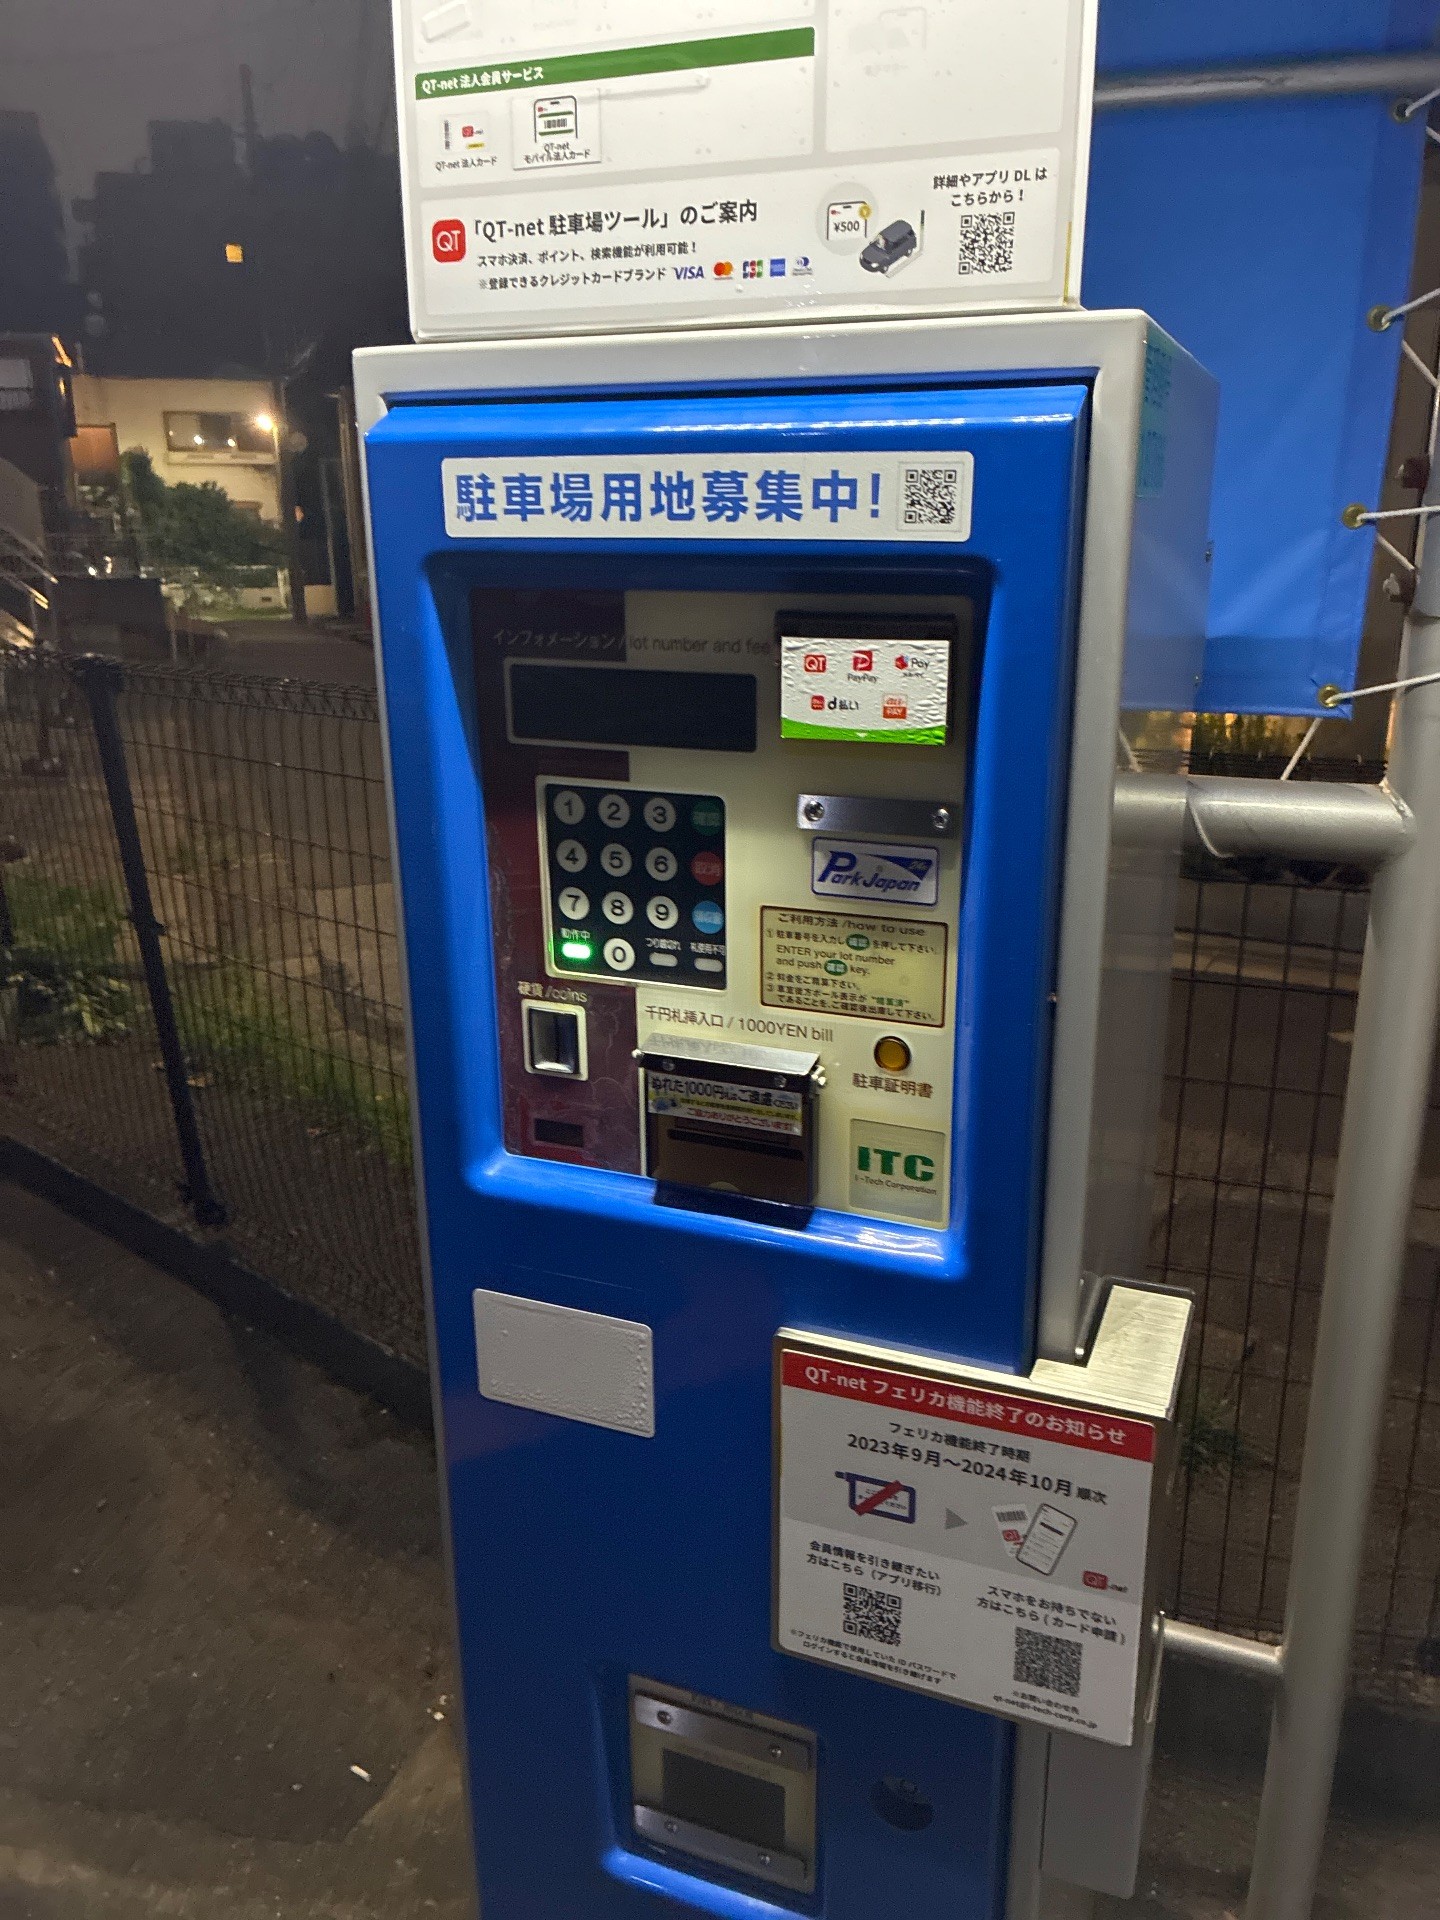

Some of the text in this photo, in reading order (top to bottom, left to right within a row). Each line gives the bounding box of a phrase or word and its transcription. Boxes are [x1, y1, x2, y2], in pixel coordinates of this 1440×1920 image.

[421, 66, 544, 94] QT-net 法人会員サービス
[1014, 169, 1030, 182] DL
[436, 230, 461, 252] QT
[673, 265, 704, 280] VISA
[652, 637, 707, 653] number
[713, 638, 742, 654] and
[805, 657, 826, 671] QT
[910, 658, 930, 669] Pay
[847, 673, 878, 685] PayPay
[564, 799, 573, 816] 1
[607, 802, 621, 820] 2
[653, 805, 667, 824] 3
[565, 848, 578, 864] 4
[609, 851, 623, 868] 5
[654, 855, 669, 873] 6
[567, 894, 580, 912] 7
[610, 899, 624, 916] 8
[655, 904, 669, 921] 9
[612, 946, 627, 963] 0
[776, 944, 811, 956] ENTER
[645, 1005, 724, 1028] 千円札挿入口
[738, 1018, 808, 1039] 1000YEN
[812, 1027, 834, 1043] bill
[852, 1073, 933, 1098] 駐車証明書
[857, 1145, 934, 1181] ITC
[805, 1366, 867, 1391] QT-net
